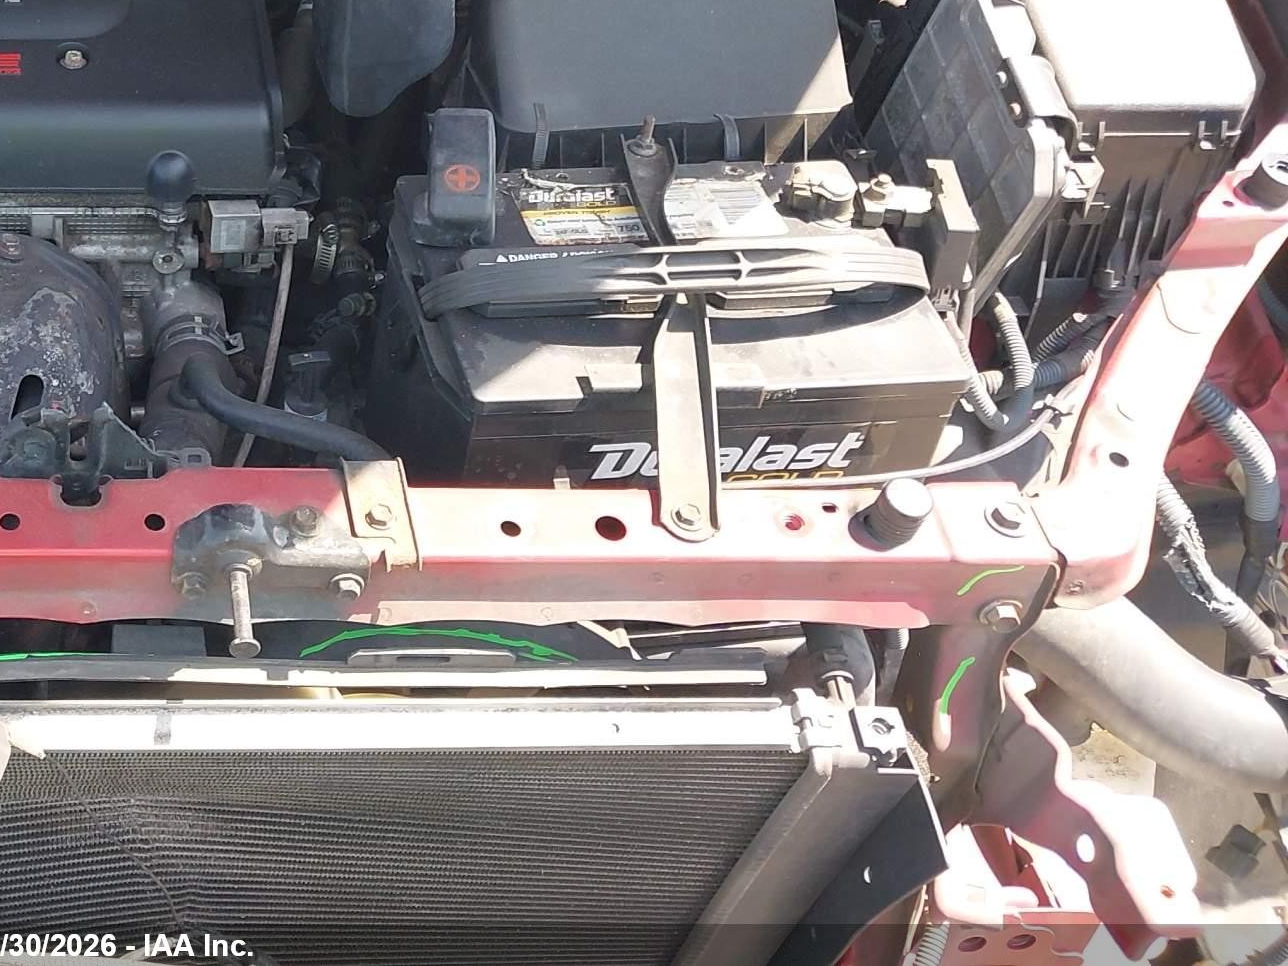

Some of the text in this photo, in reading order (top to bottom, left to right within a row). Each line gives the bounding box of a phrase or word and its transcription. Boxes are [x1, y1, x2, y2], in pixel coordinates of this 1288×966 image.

[528, 187, 616, 203] Duralast
[617, 224, 640, 233] 750
[588, 432, 864, 480] Dualast
